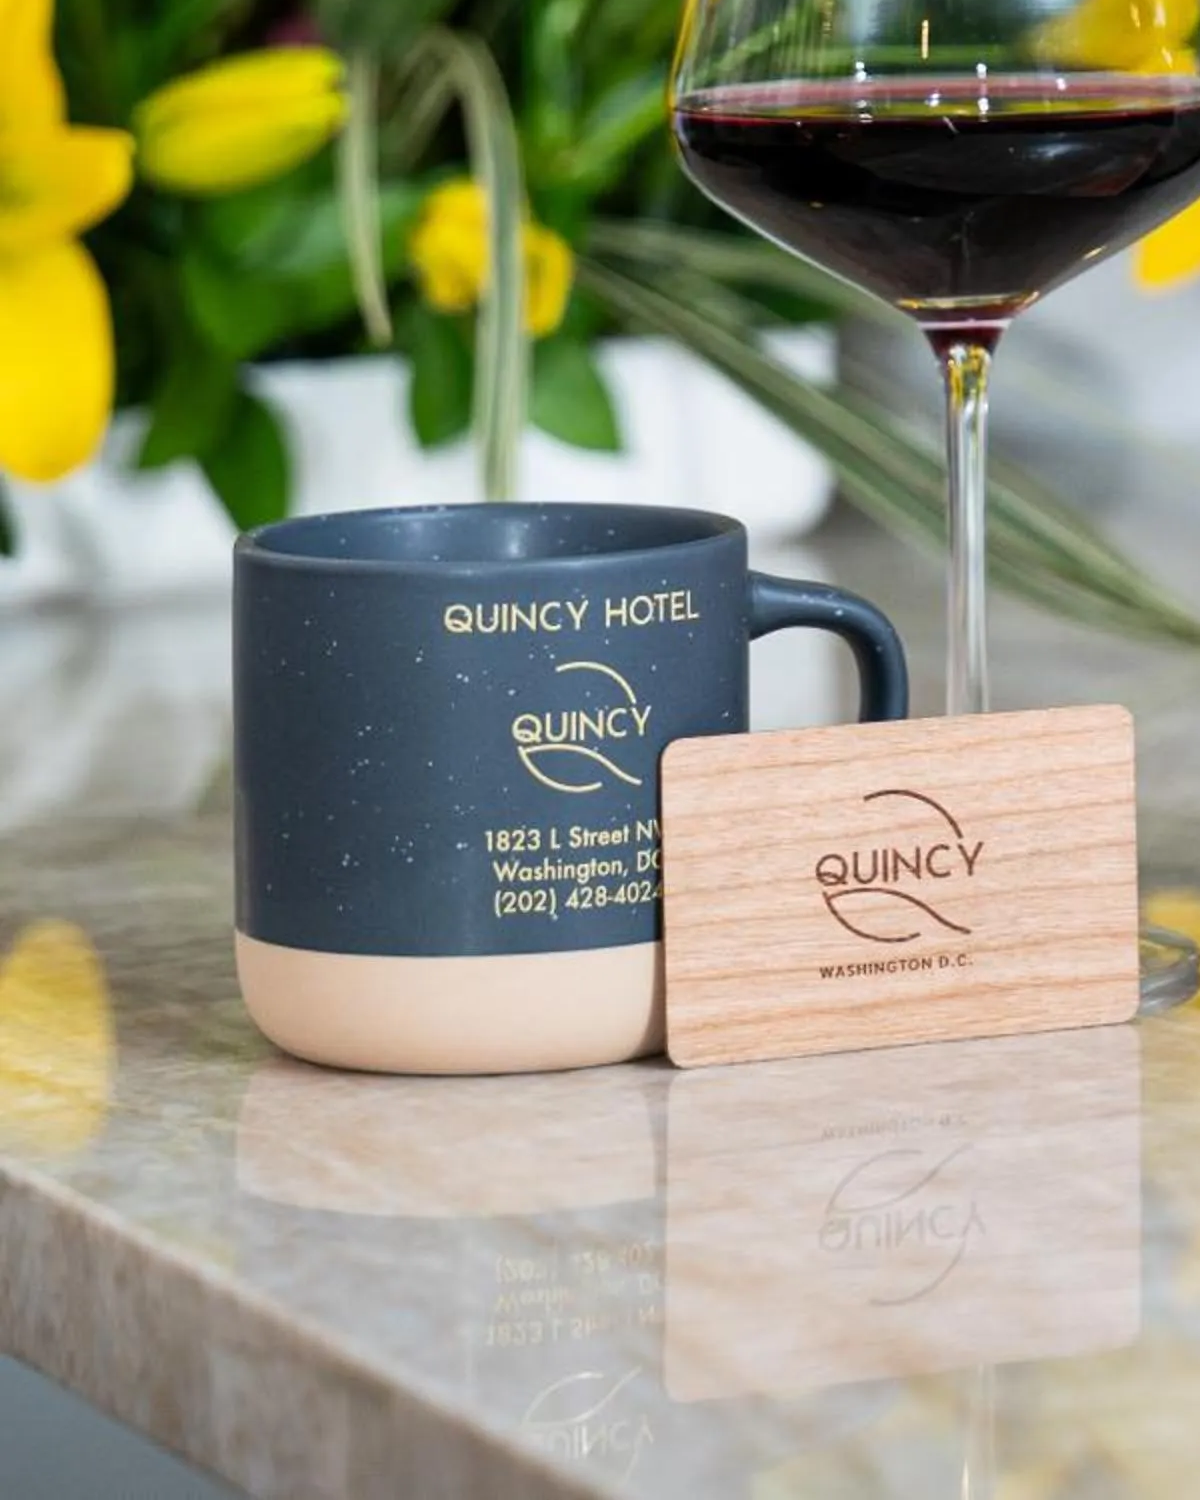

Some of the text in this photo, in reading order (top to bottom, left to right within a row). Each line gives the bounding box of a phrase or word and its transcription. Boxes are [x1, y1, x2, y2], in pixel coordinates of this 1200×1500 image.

[444, 590, 700, 633] QUINCY HOTEL
[512, 705, 652, 743] QUINCY
[484, 828, 541, 853] 1823
[551, 827, 561, 850] L
[569, 825, 630, 849] Street
[493, 856, 629, 885] Washington,
[816, 841, 984, 887] QUINCY
[494, 888, 557, 919] (202)
[819, 953, 974, 979] WASHINGTON D.C.
